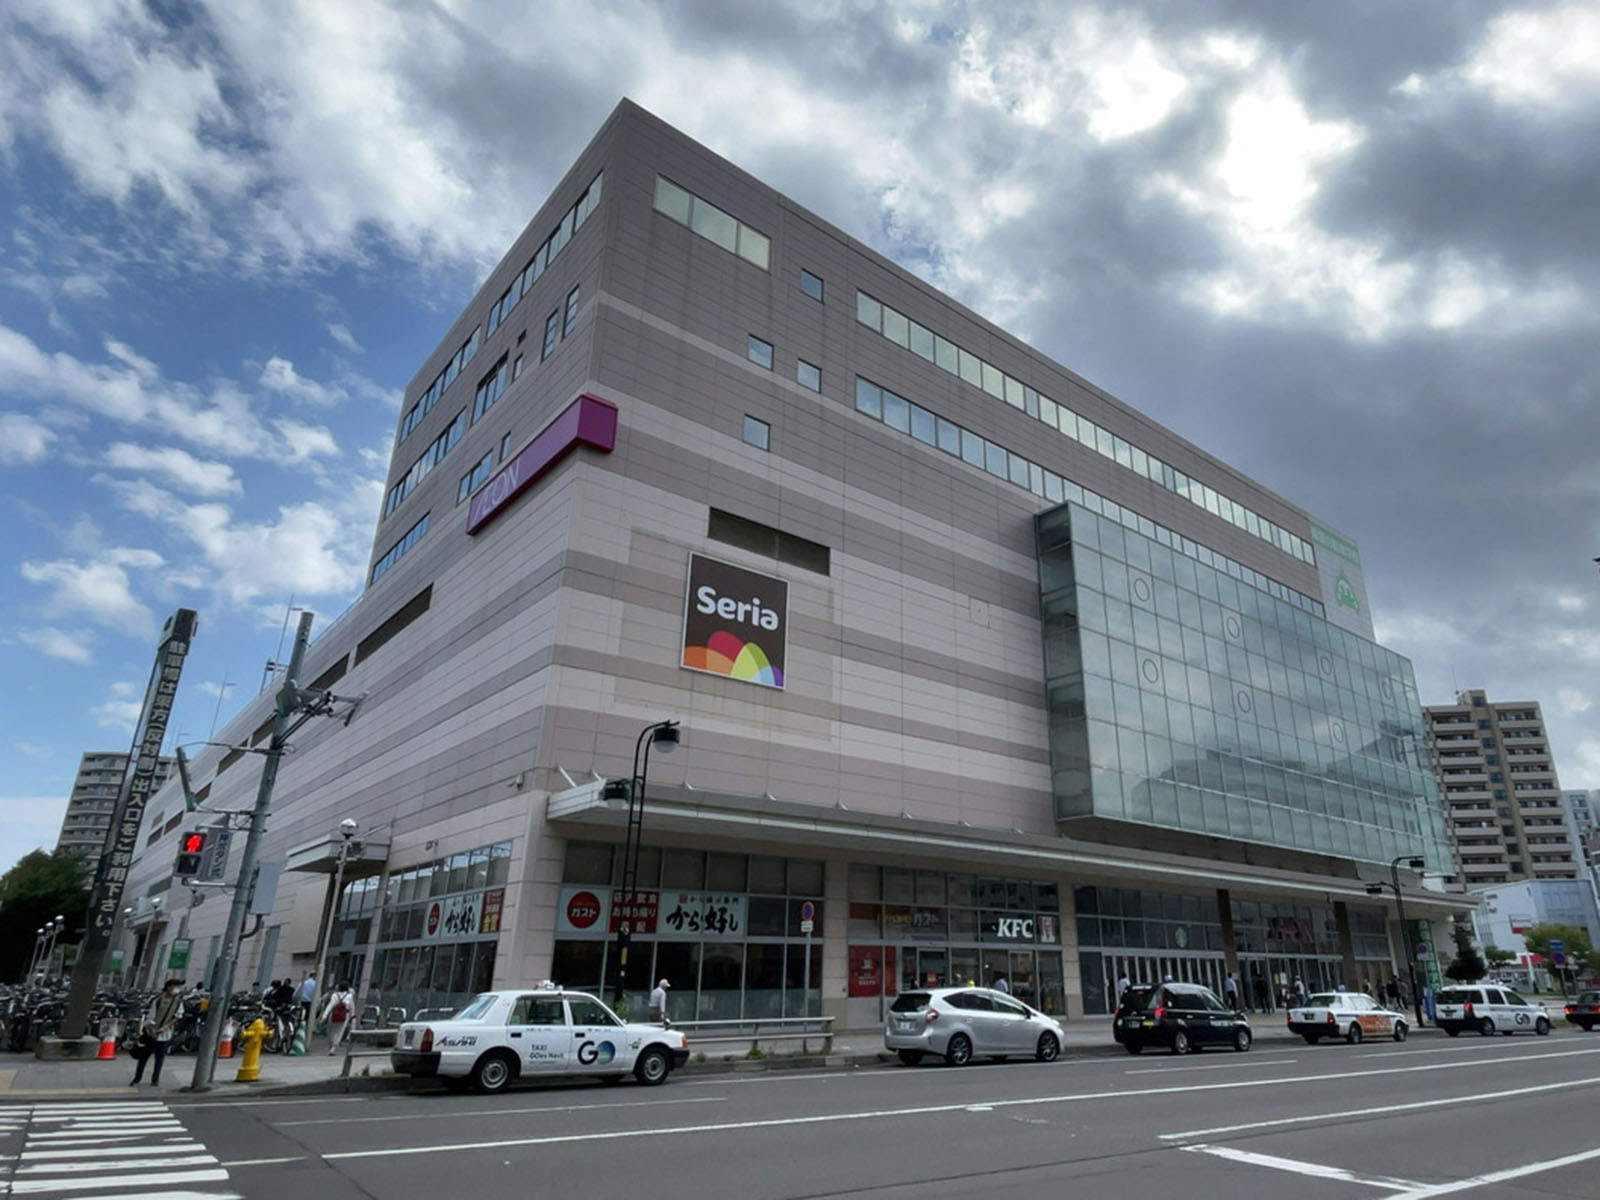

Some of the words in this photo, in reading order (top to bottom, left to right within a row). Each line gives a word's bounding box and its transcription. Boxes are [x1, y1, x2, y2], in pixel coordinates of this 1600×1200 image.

[697, 585, 779, 631] Seria
[571, 907, 597, 918] ガスト
[666, 904, 739, 934] から好し
[997, 917, 1033, 939] KFC
[578, 1040, 616, 1066] GO
